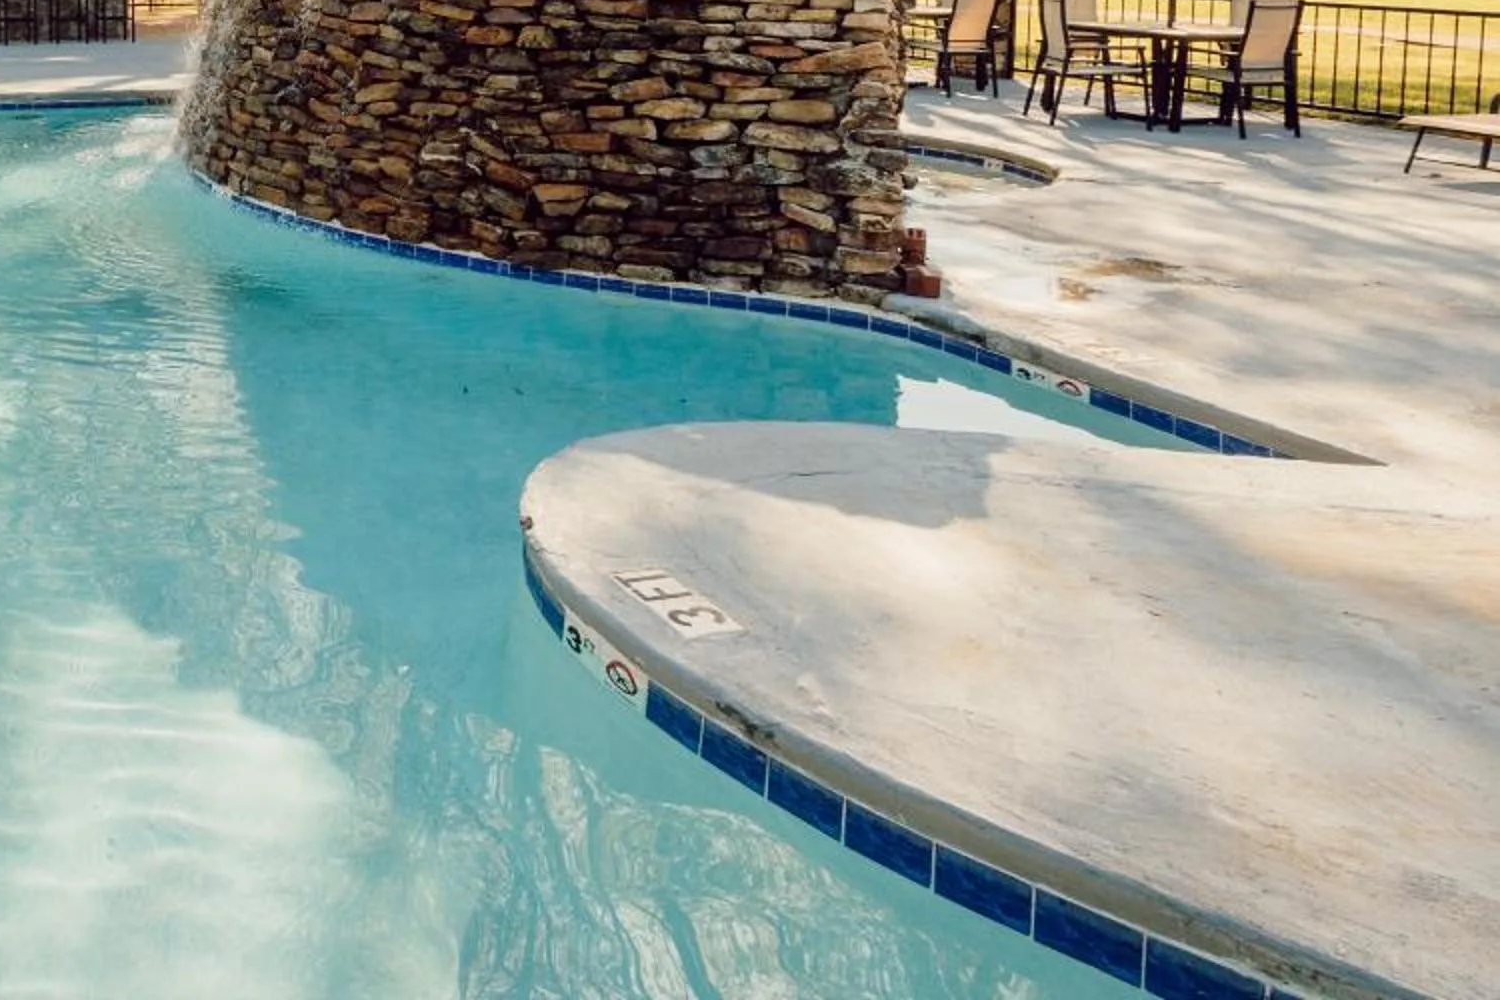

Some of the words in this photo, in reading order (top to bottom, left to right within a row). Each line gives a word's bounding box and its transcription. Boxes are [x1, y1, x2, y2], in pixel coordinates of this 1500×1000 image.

[614, 575, 692, 602] FT
[667, 606, 726, 627] 3
[566, 625, 582, 654] 3
